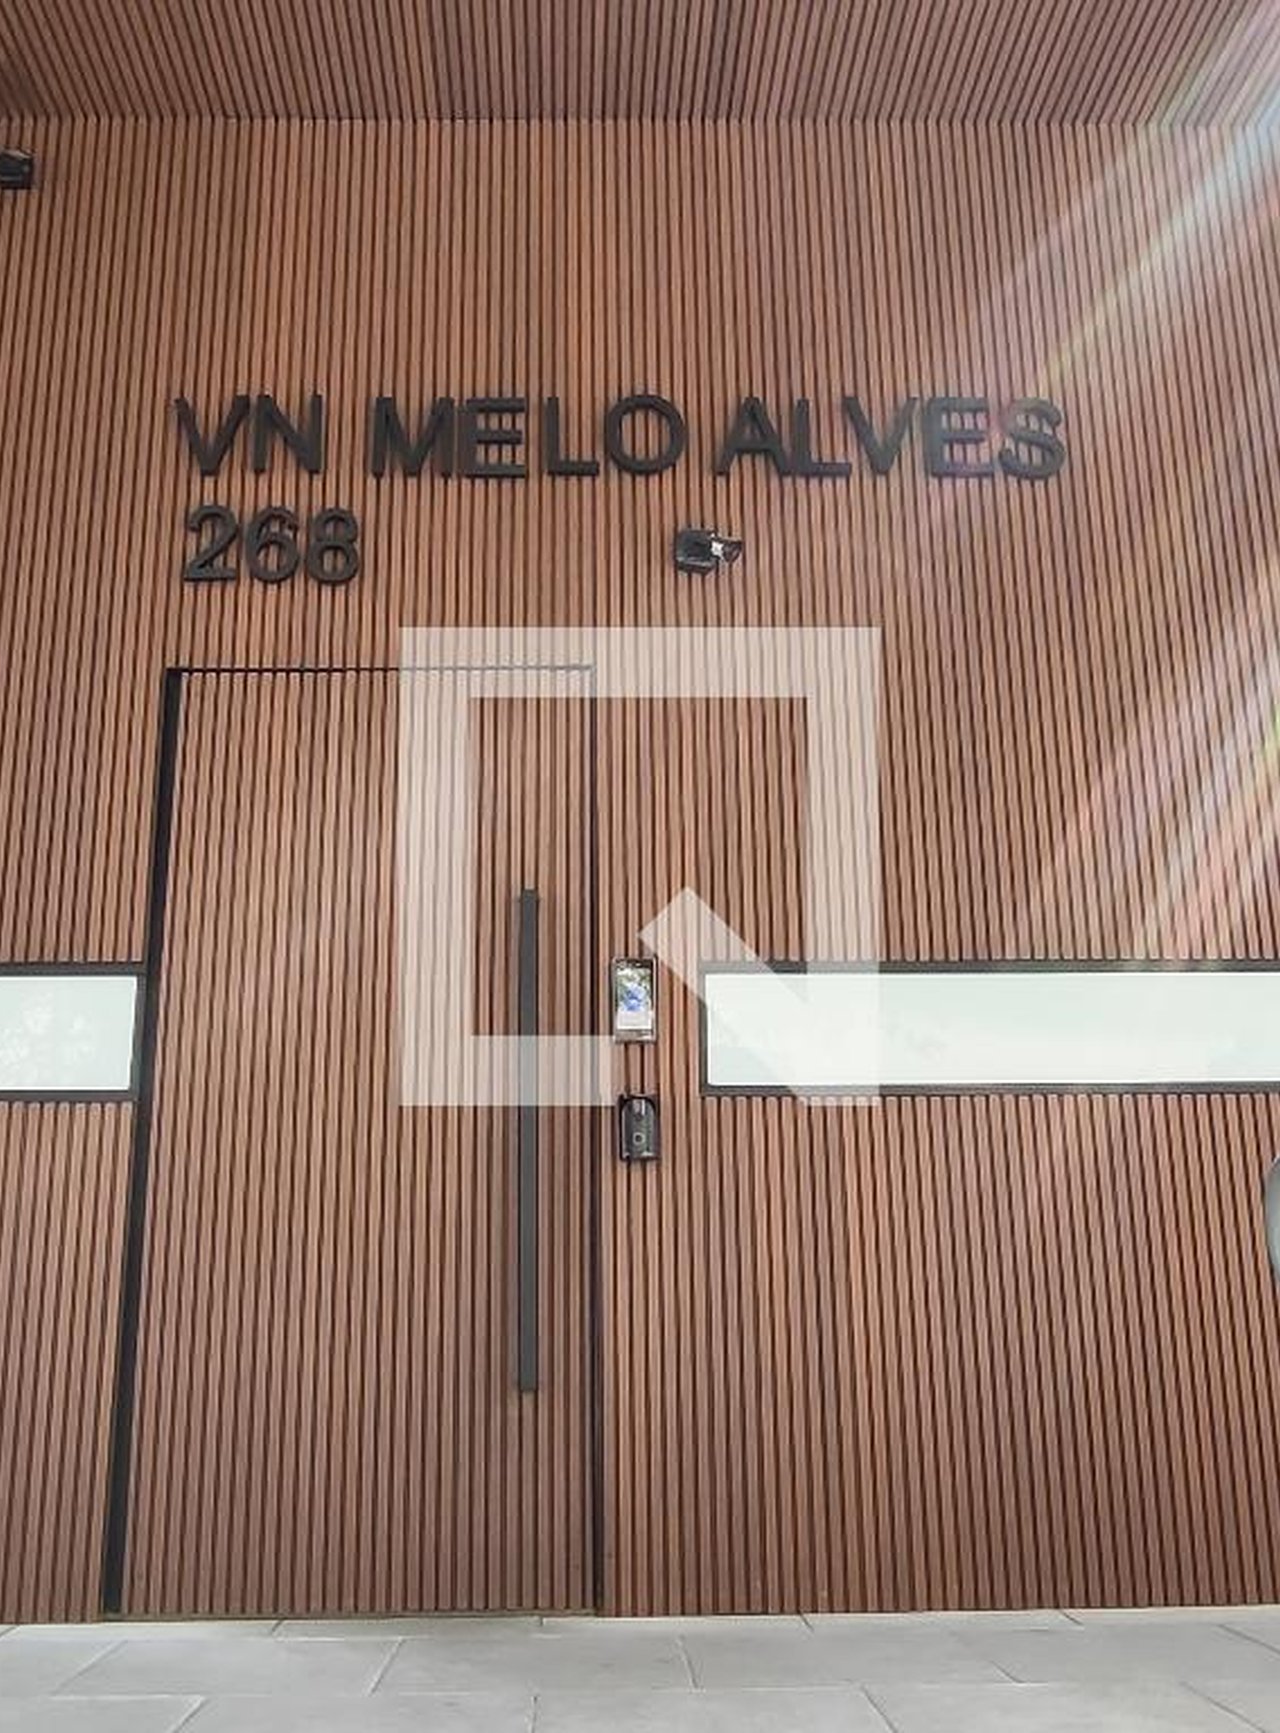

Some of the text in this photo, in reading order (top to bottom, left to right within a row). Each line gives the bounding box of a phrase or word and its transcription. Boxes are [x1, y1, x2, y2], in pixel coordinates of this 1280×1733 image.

[175, 394, 1067, 480] VN MELO ALVES
[184, 504, 360, 584] 268
